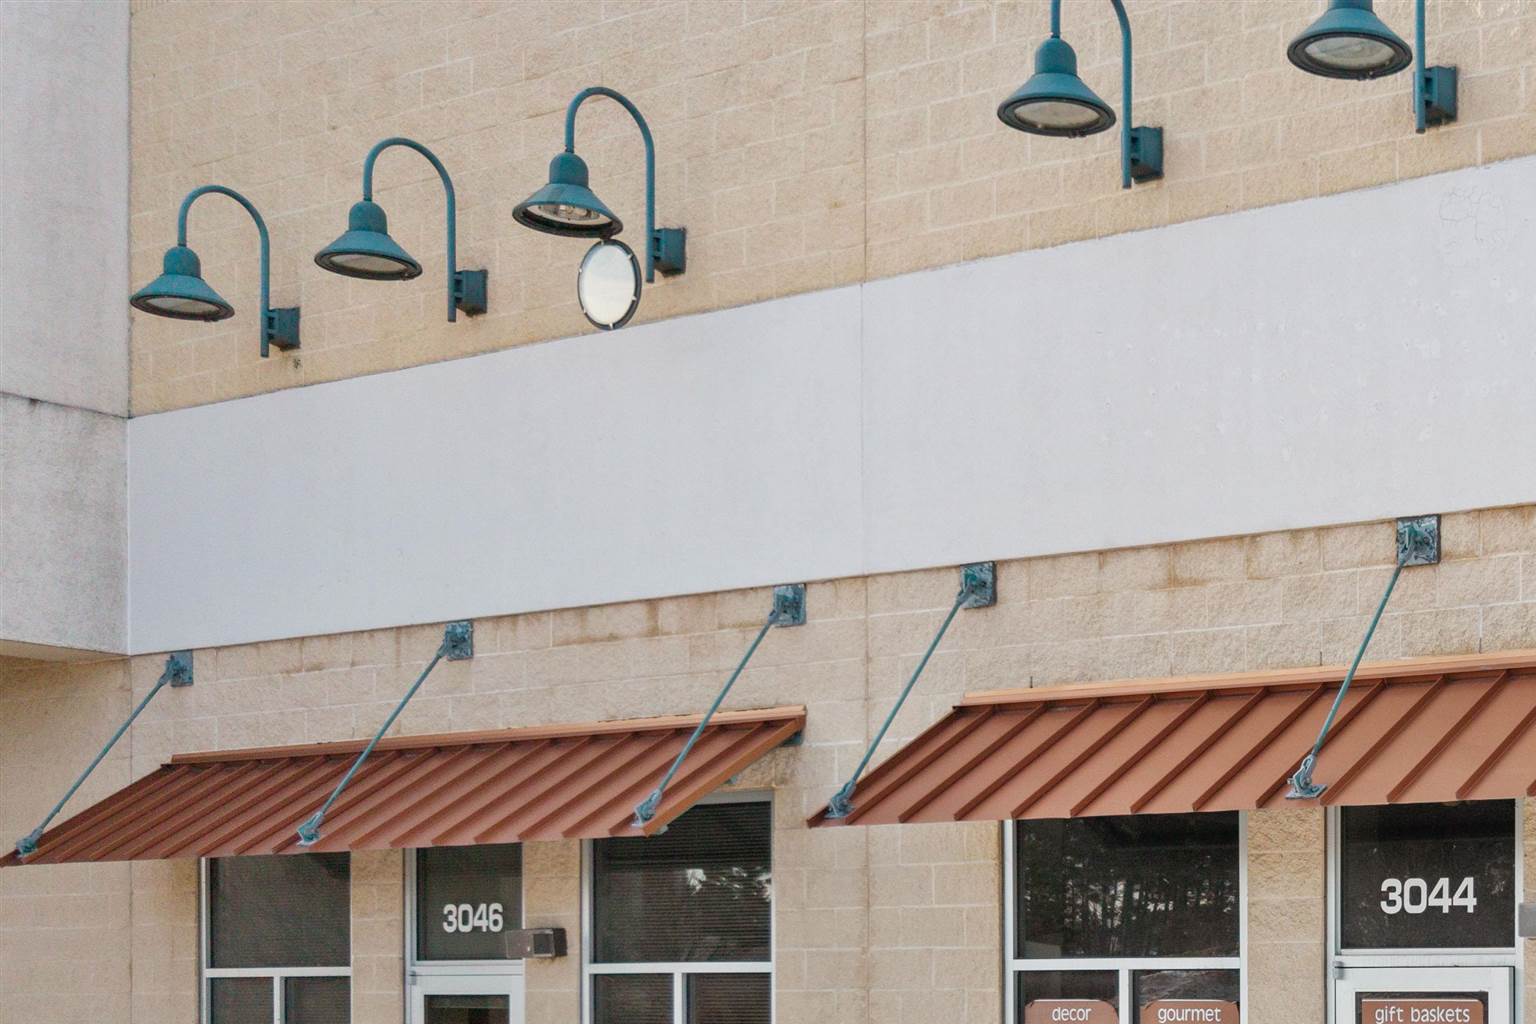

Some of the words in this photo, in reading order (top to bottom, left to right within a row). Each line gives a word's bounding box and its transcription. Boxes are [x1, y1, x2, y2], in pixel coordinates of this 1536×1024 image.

[1380, 877, 1477, 914] 3044
[443, 903, 503, 933] 3046
[1052, 1007, 1092, 1022] decor
[1158, 1007, 1221, 1023] gourmet
[1375, 1006, 1403, 1024] gift
[1410, 1006, 1470, 1023] baskets
